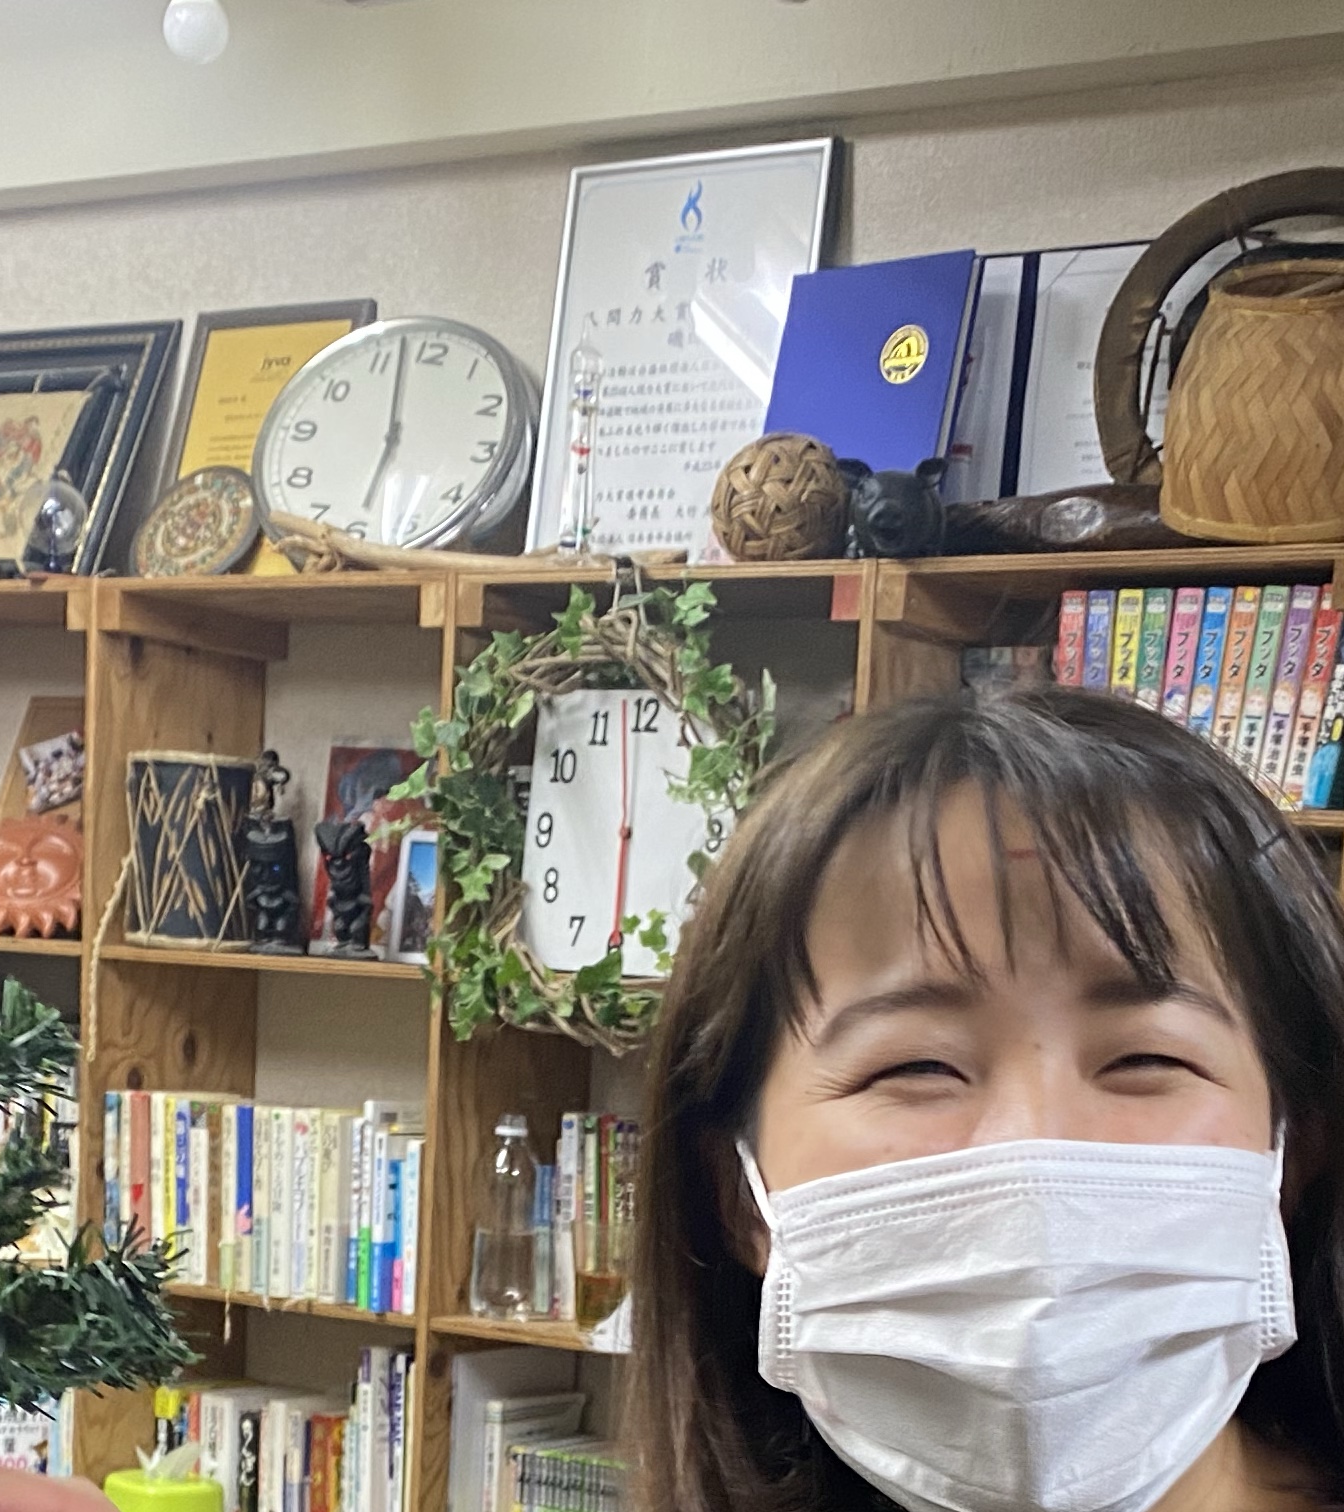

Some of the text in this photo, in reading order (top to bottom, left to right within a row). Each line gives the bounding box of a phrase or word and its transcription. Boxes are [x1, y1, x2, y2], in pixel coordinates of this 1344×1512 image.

[369, 351, 390, 375] 11
[416, 339, 449, 366] 12
[466, 358, 479, 381] 1
[323, 379, 351, 403] 10
[474, 394, 504, 418] 2
[290, 420, 318, 442] 9
[469, 440, 498, 464] 3
[286, 466, 313, 489] 8
[439, 483, 464, 504] 4
[309, 503, 331, 522] 7
[632, 696, 660, 732] 12
[588, 711, 609, 747] 11
[549, 749, 576, 784] 10
[535, 812, 553, 848] 9
[543, 867, 559, 904] 8
[569, 915, 586, 948] 7
